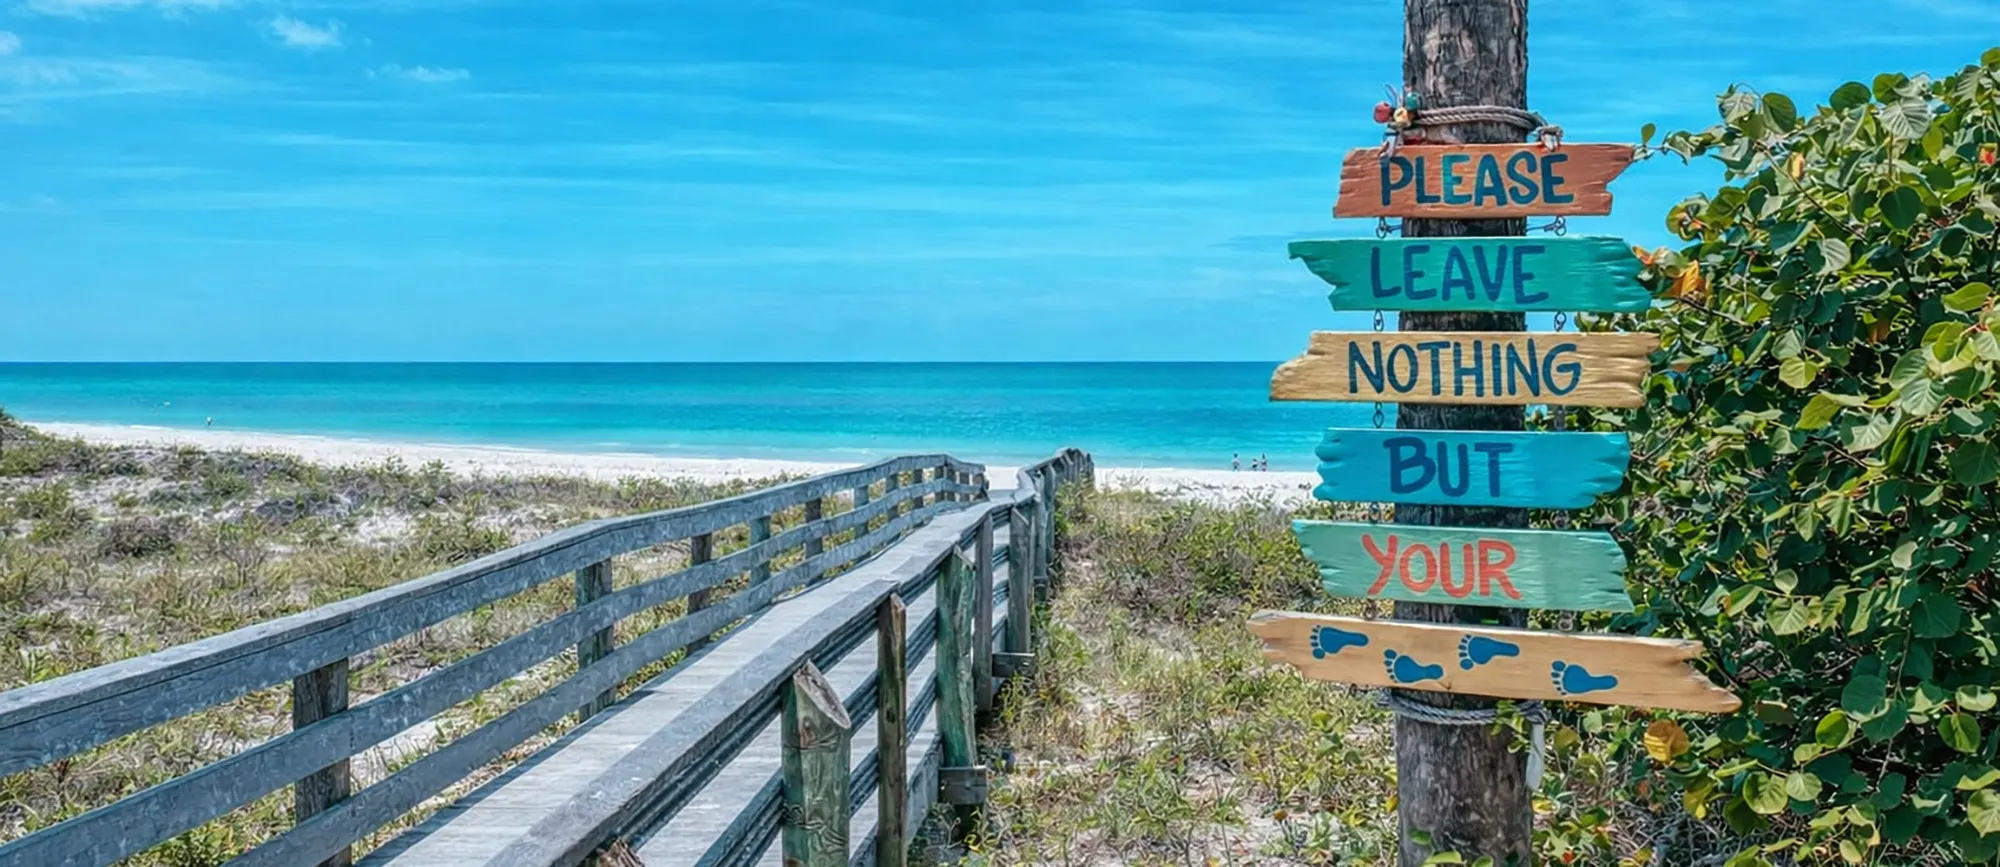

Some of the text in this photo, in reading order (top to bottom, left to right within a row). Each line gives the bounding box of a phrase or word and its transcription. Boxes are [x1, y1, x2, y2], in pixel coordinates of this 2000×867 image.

[1380, 151, 1574, 207] PLEASE
[1371, 244, 1550, 304] LEAVE
[1348, 338, 1581, 397] NOTHING
[1383, 437, 1512, 498] BUT
[1361, 533, 1522, 600] YOUR
